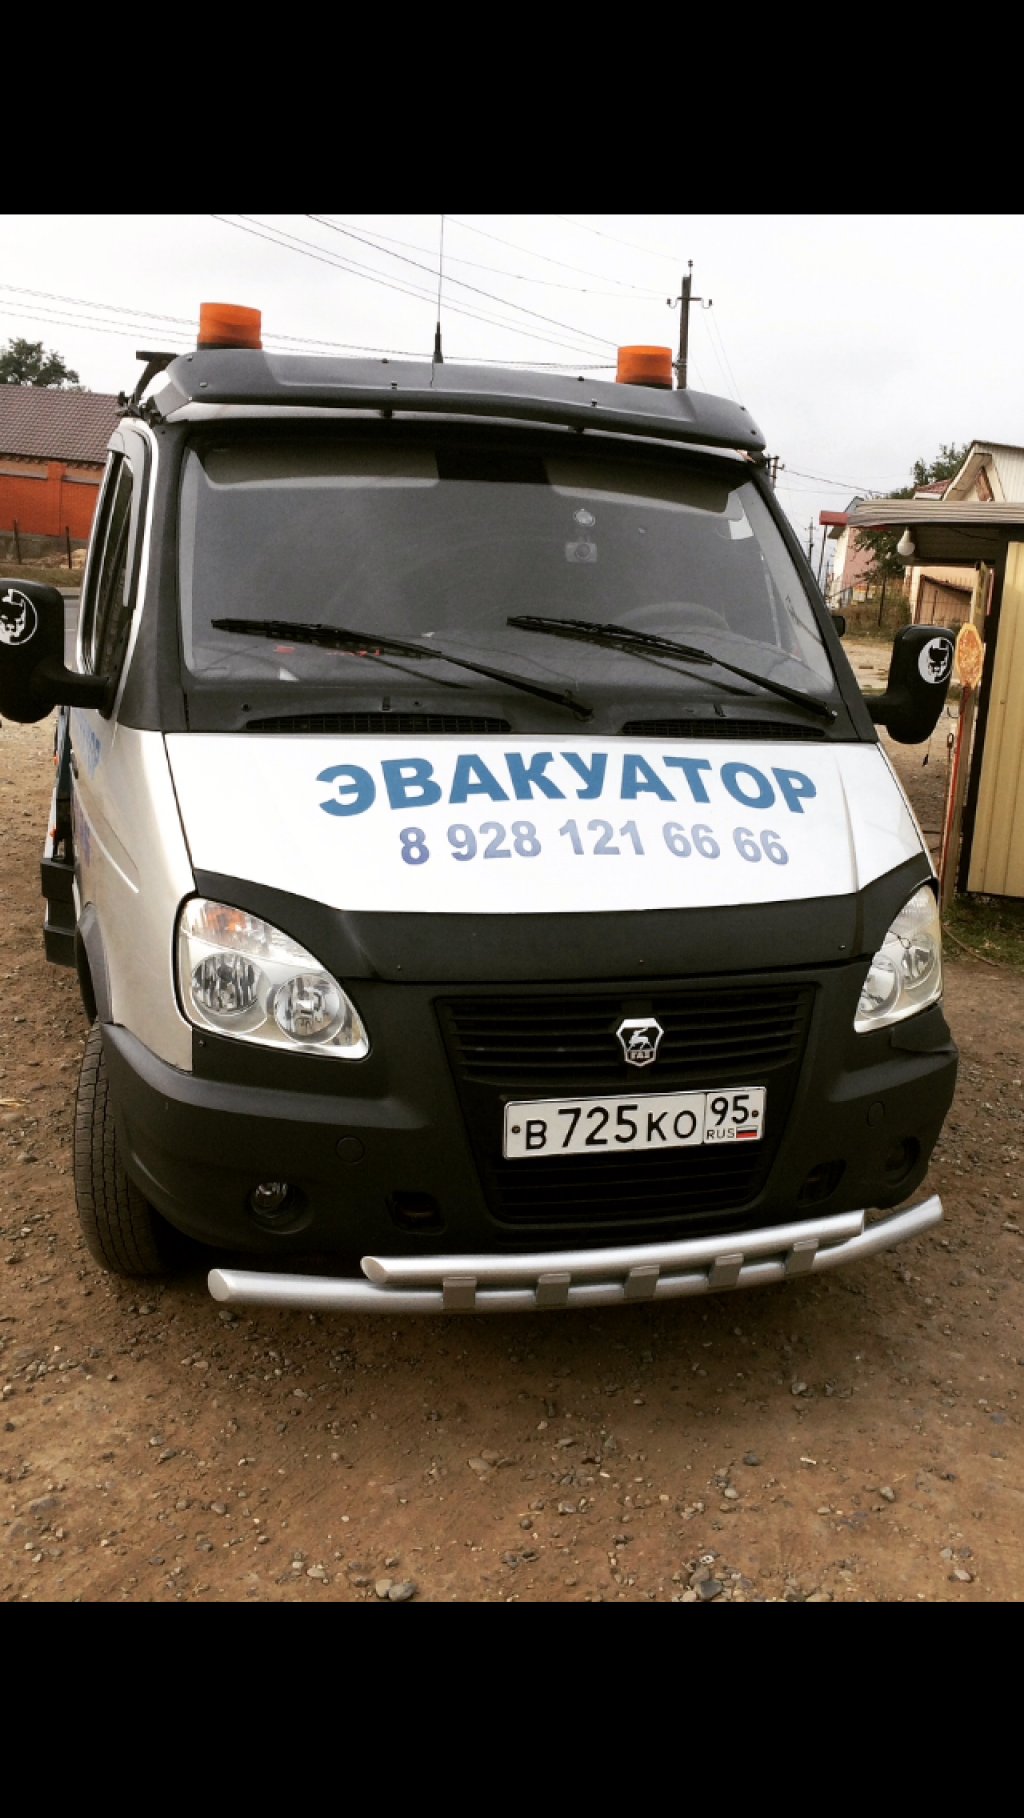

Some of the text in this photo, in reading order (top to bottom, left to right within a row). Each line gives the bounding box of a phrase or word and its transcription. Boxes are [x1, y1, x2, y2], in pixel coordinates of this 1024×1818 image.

[316, 752, 817, 816] ЭВАКУАТОР
[400, 819, 789, 866] 8 928 121 66 66
[710, 1096, 750, 1127] 95
[706, 1127, 735, 1140] RUS
